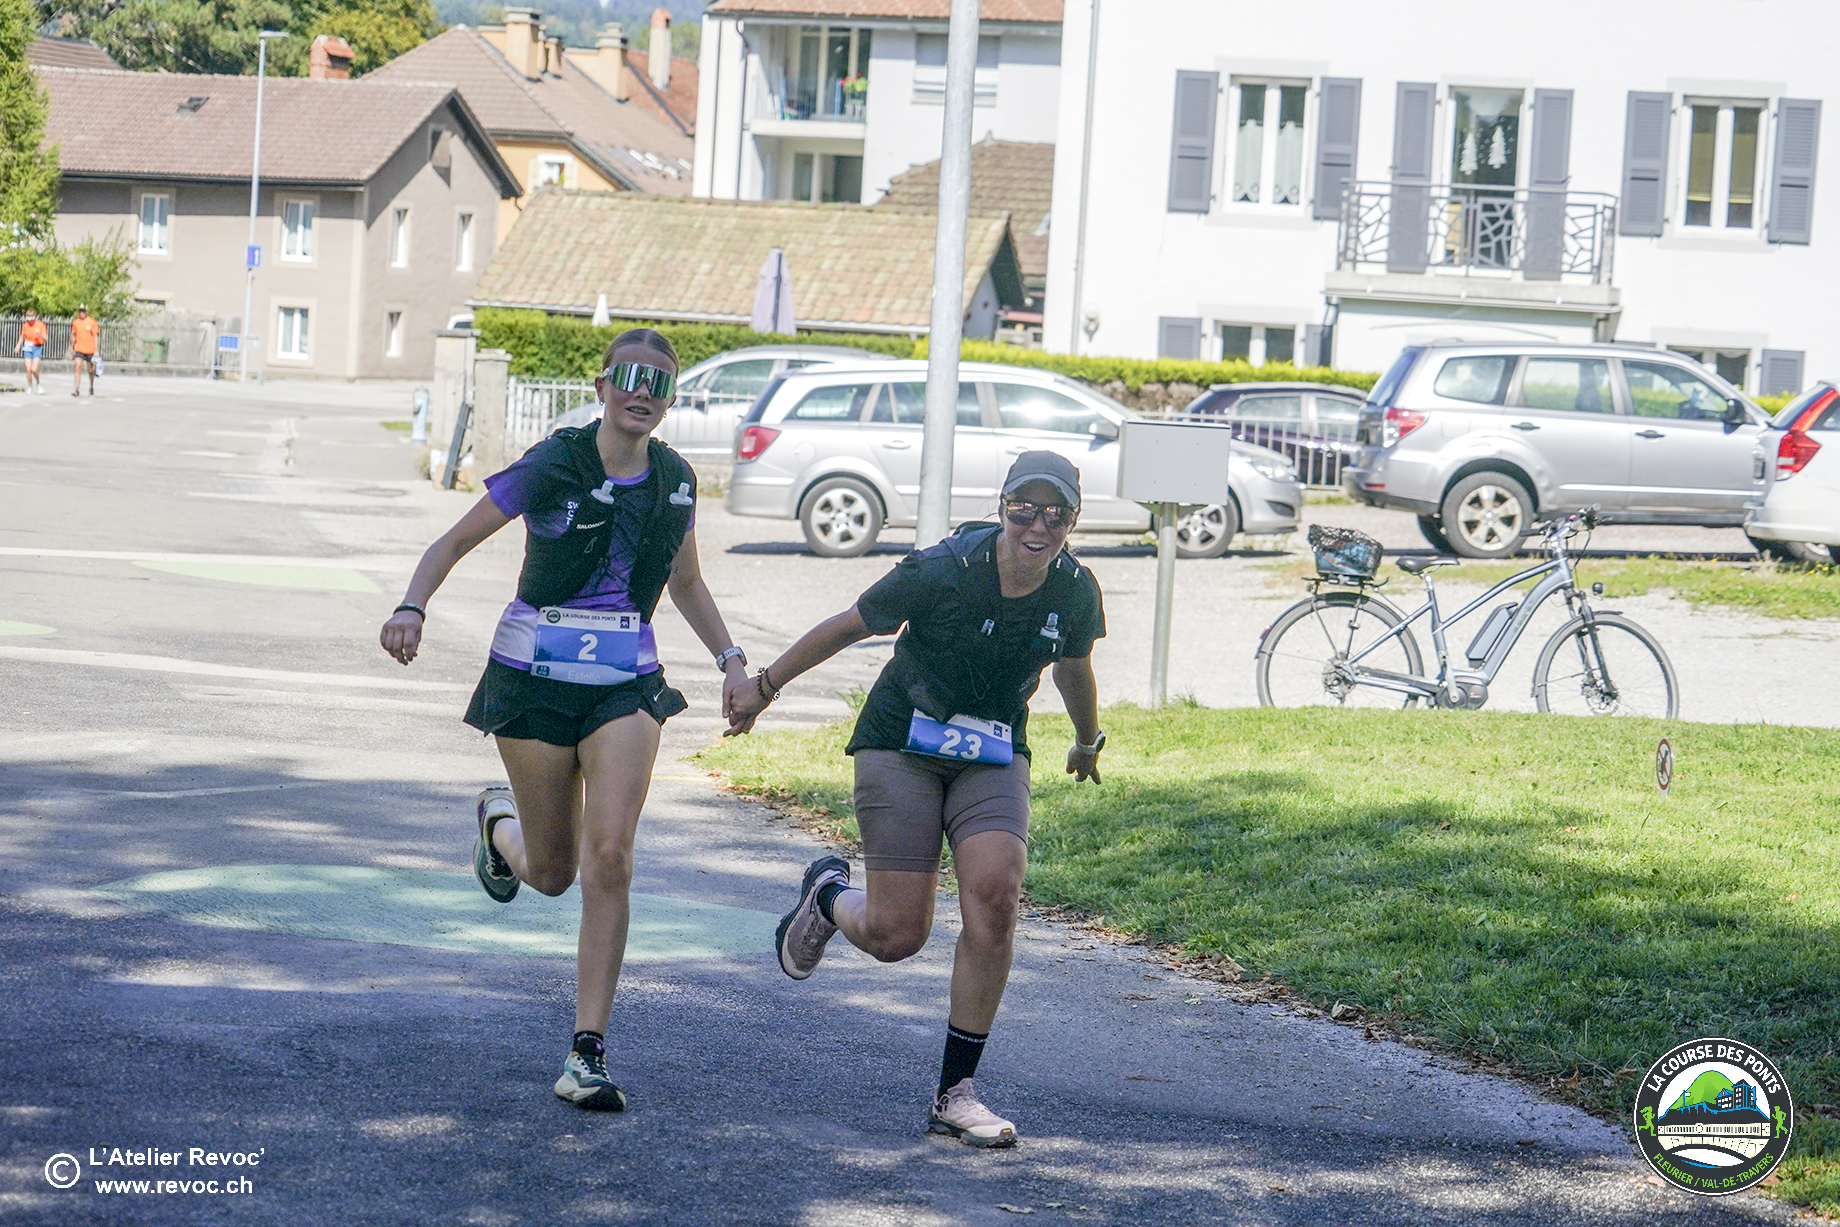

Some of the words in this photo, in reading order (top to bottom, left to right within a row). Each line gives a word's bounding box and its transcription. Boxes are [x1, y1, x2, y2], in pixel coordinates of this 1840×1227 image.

[578, 633, 598, 661] 2
[567, 670, 601, 682] Estelle
[938, 728, 982, 760] 23
